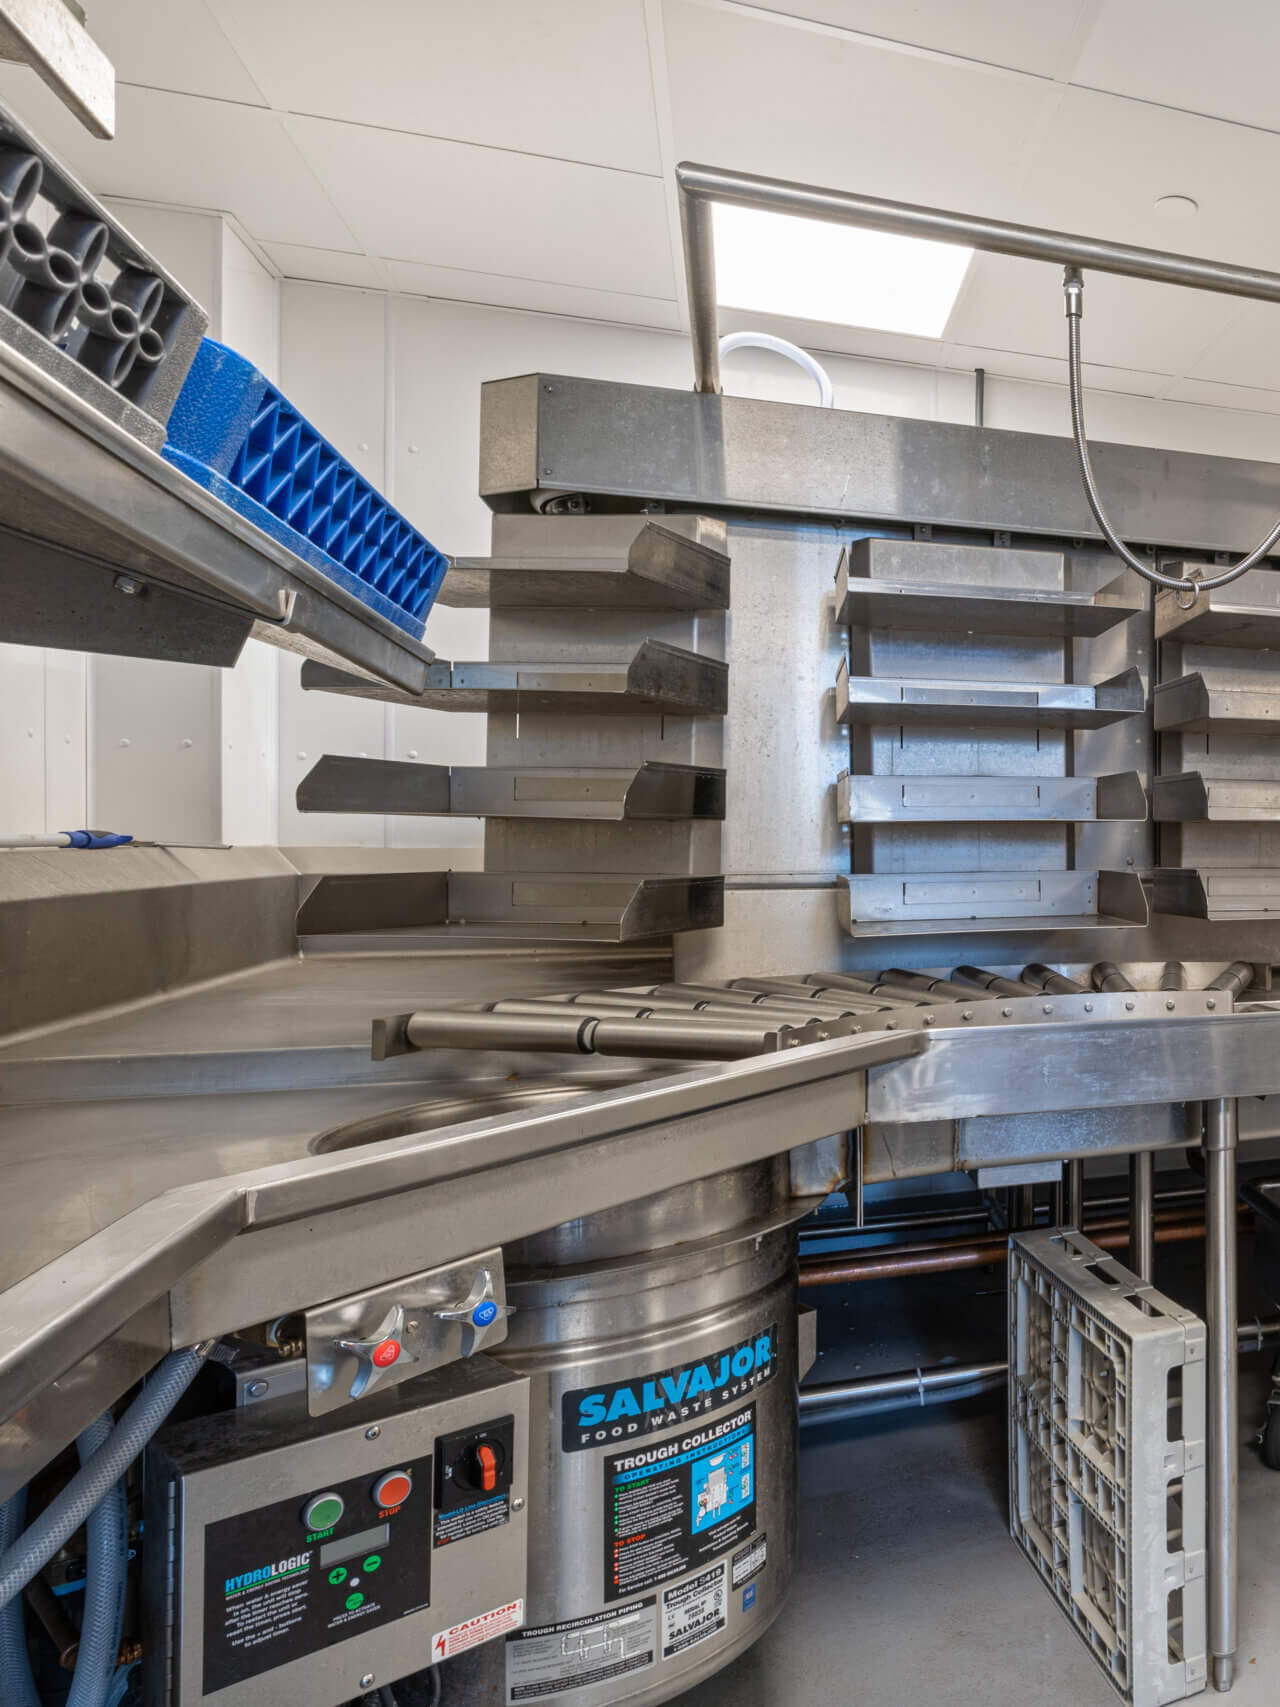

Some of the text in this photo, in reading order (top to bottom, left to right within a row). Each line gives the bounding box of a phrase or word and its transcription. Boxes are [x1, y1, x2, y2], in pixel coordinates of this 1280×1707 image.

[578, 1336, 771, 1426] SALVAJOR
[581, 1368, 771, 1443] FOOD WASTE SYSTEM
[614, 1411, 751, 1471] TROUGH COLLECTOR
[625, 1457, 681, 1480] OPERATING
[627, 1479, 650, 1490] START
[379, 1506, 400, 1519] STOP
[306, 1528, 334, 1543] START
[626, 1533, 646, 1544] STOP
[225, 1552, 310, 1592] HYDROLOGIC
[666, 1594, 691, 1610] Trough
[693, 1578, 723, 1598] Collector
[668, 1580, 698, 1600] Model
[449, 1603, 516, 1635] CAUTION
[523, 1602, 643, 1637] TROUGH RECIRCULATION PIPING
[669, 1608, 720, 1640] SALVAJOR
